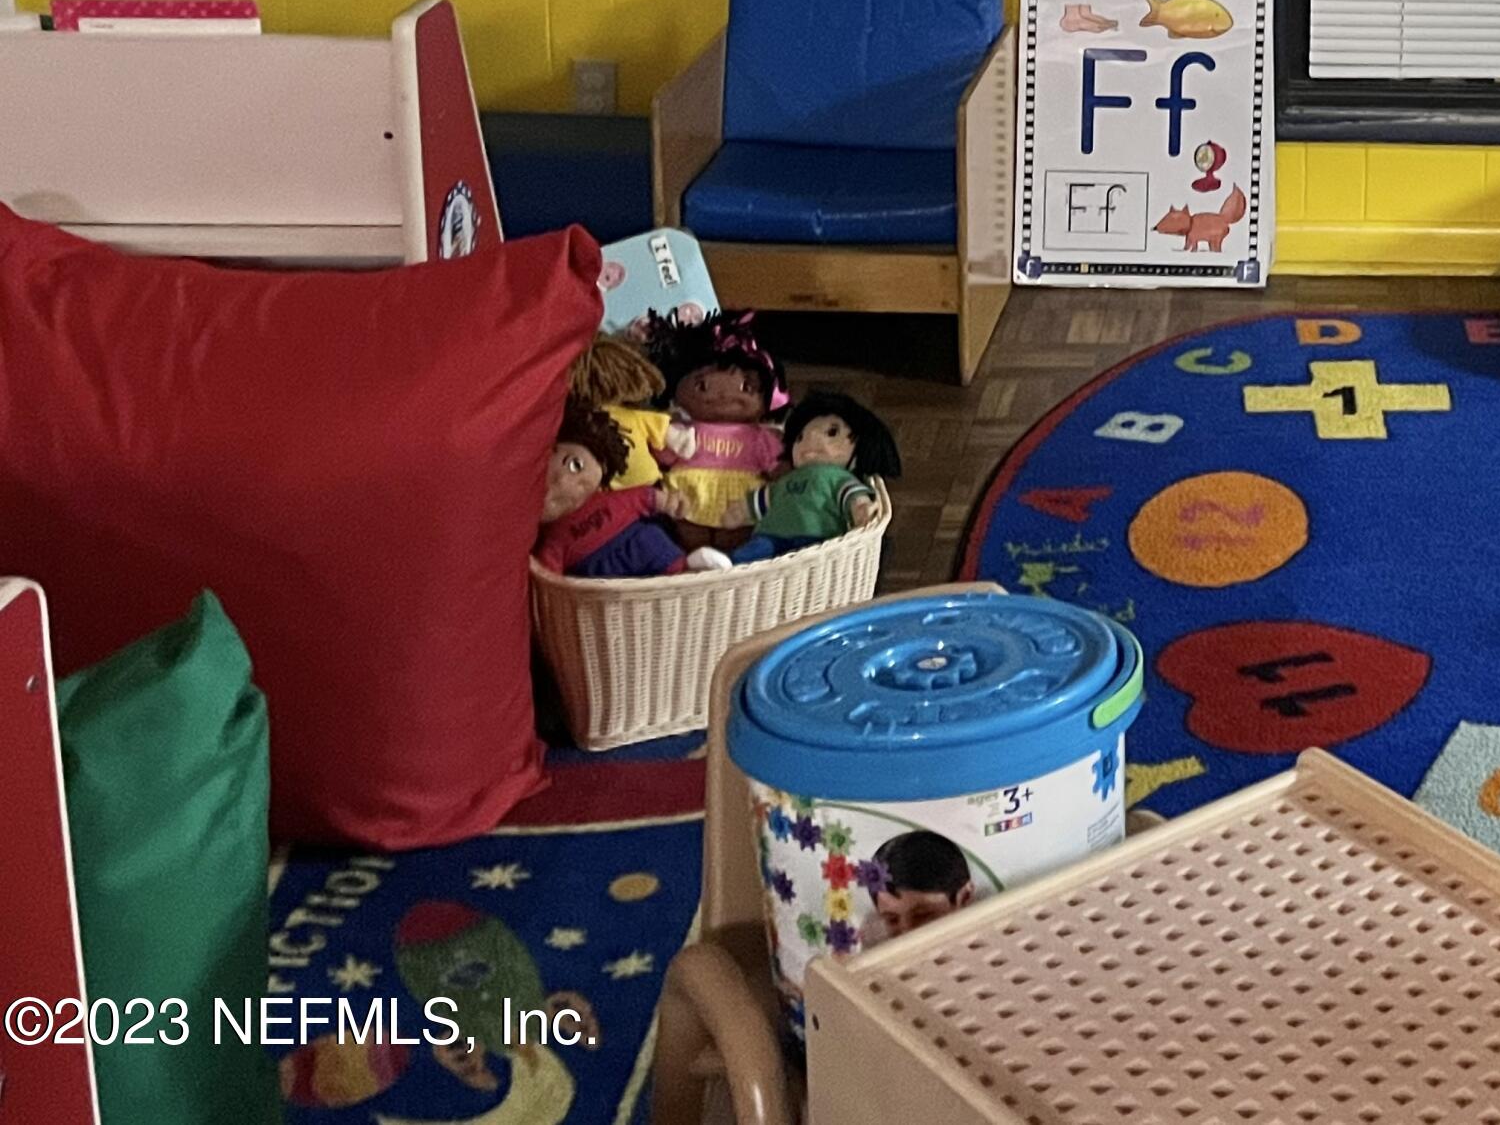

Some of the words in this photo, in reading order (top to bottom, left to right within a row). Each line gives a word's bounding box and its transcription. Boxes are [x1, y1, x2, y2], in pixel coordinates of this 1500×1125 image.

[1081, 48, 1217, 157] Ff
[1067, 182, 1127, 234] Ff
[1295, 318, 1362, 345] D
[1174, 347, 1252, 375] C
[1321, 385, 1358, 417] 1
[1093, 411, 1184, 443] B
[1018, 486, 1113, 523] A
[1003, 784, 1035, 814] 3+
